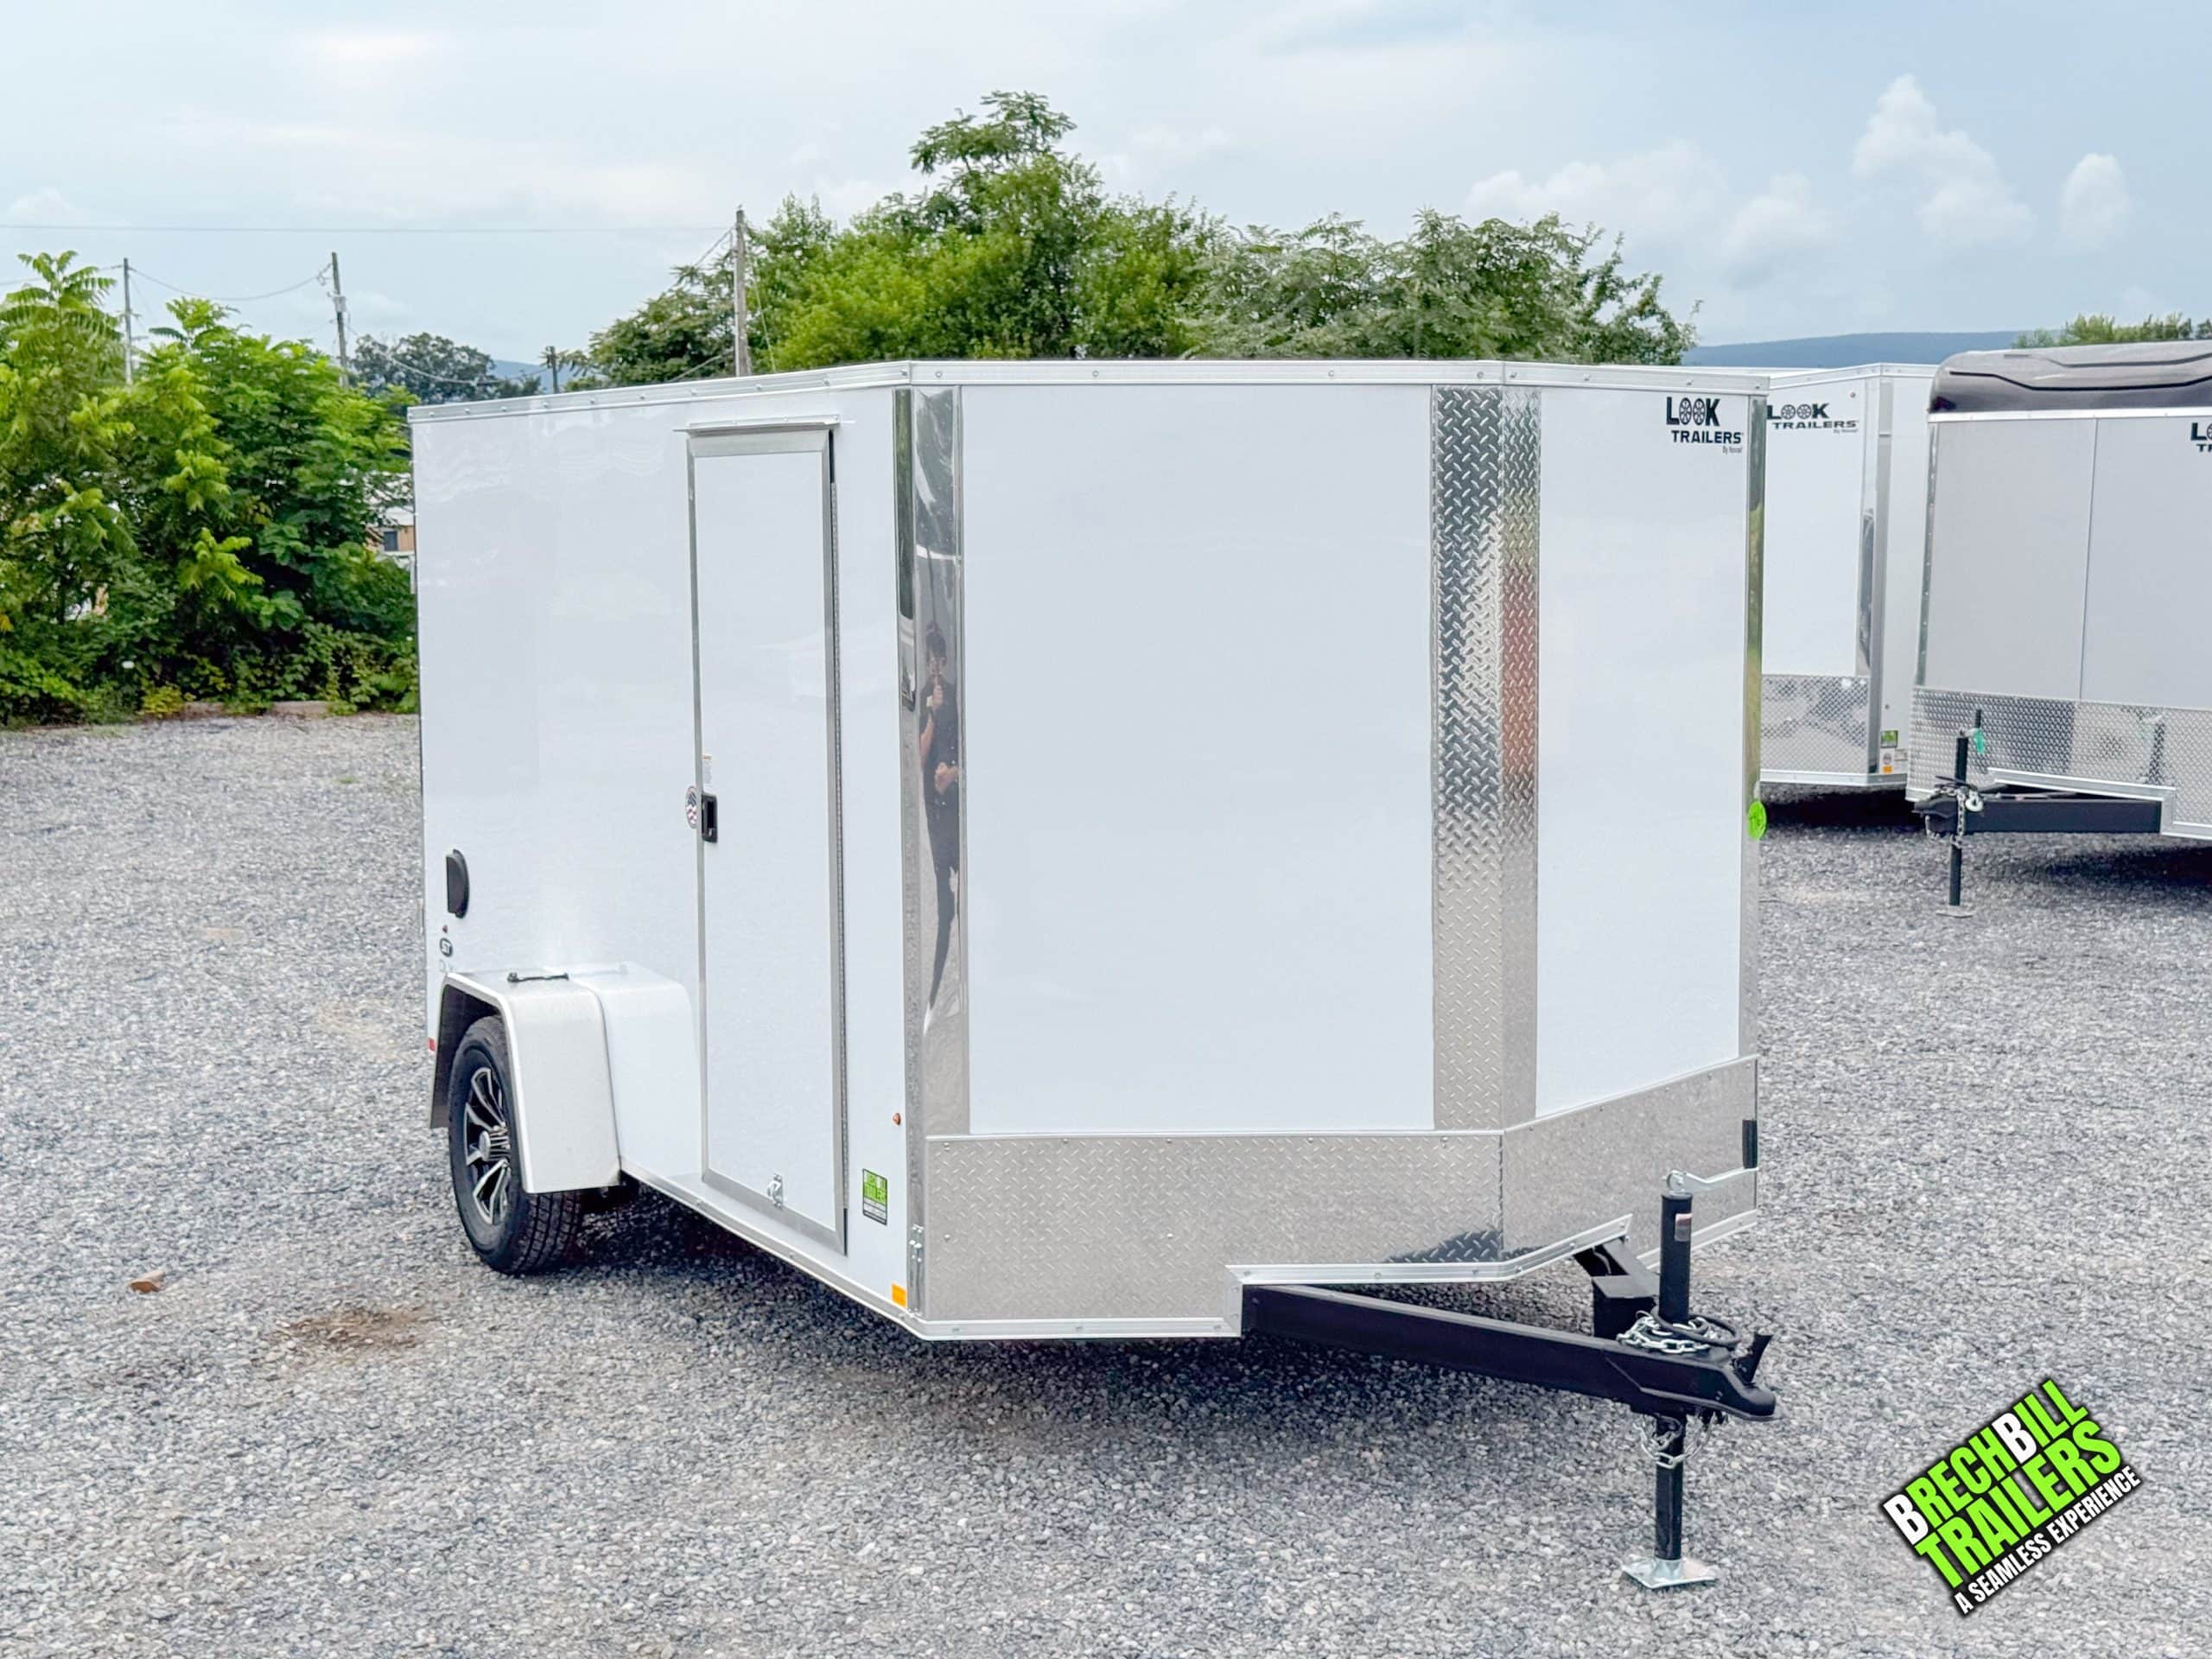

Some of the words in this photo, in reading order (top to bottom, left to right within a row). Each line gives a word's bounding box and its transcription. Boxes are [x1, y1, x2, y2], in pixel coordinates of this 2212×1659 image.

[1666, 397, 1720, 427] LOOK
[1767, 403, 1830, 420] LOOK
[1772, 420, 1857, 429] TRAILERS
[1671, 430, 1742, 444] TRAILERS
